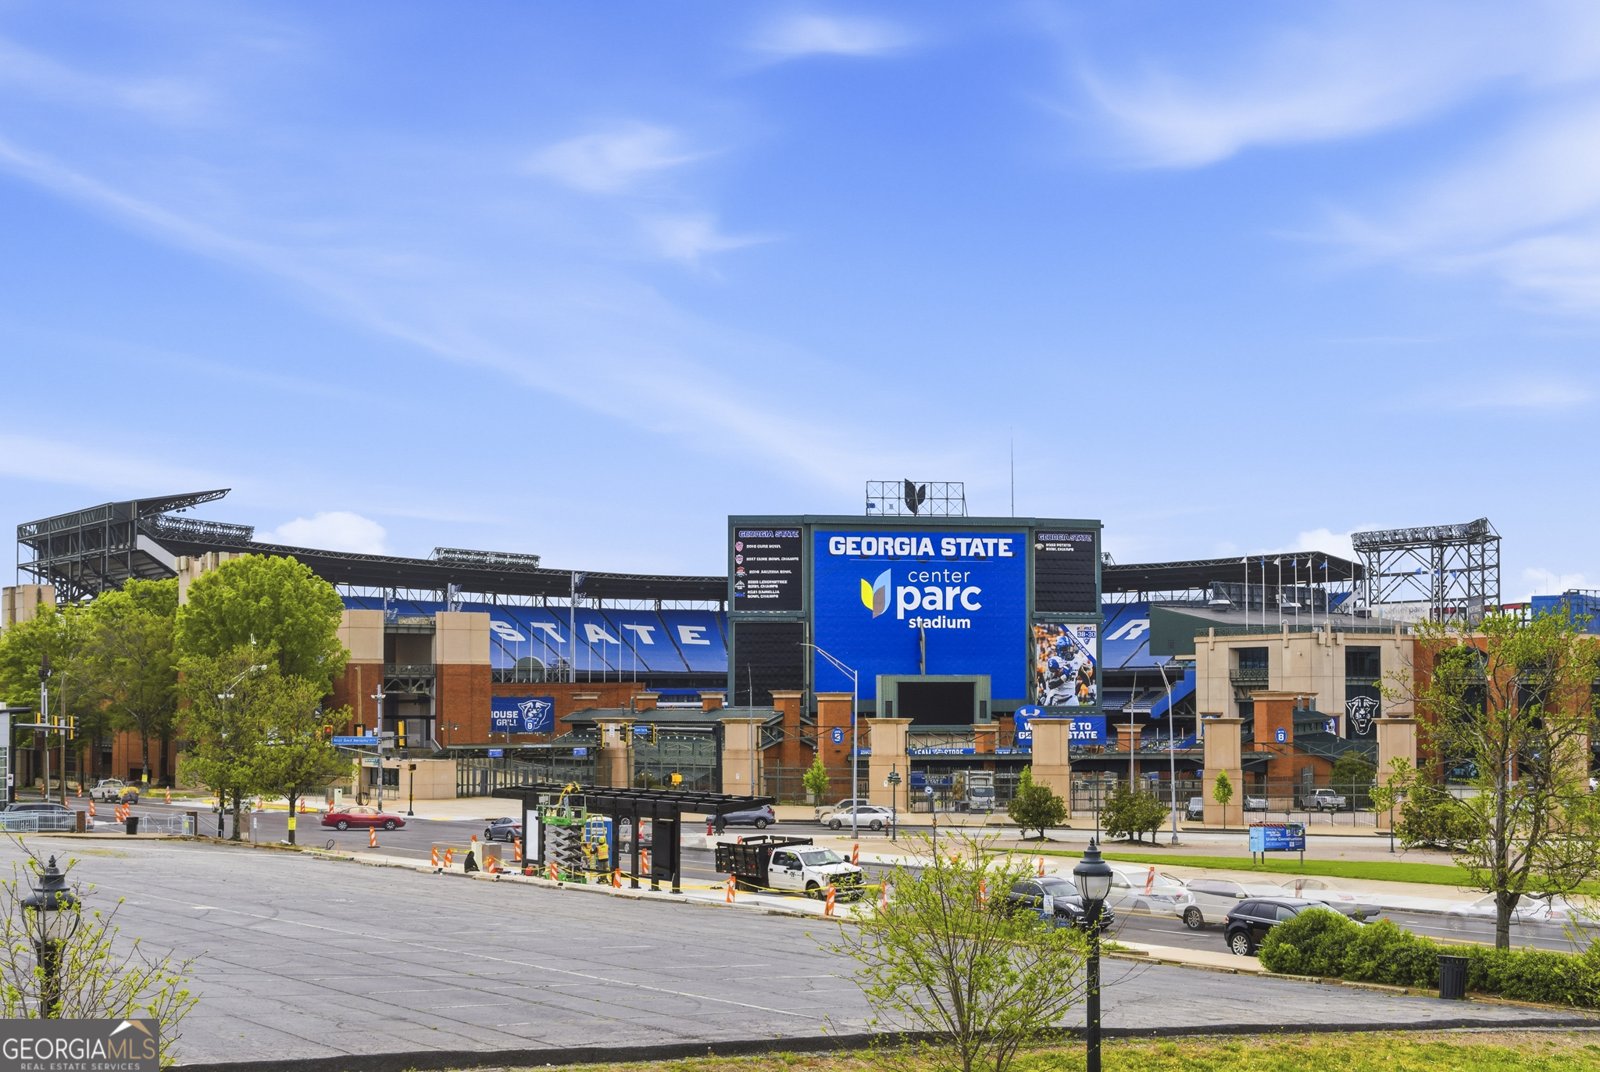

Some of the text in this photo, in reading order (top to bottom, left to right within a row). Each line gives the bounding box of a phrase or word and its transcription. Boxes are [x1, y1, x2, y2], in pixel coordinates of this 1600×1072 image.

[829, 536, 1013, 557] GEORGIA STATE
[908, 569, 971, 583] center
[896, 586, 982, 620] parc
[909, 616, 971, 629] stadium
[1078, 722, 1093, 731] TO
